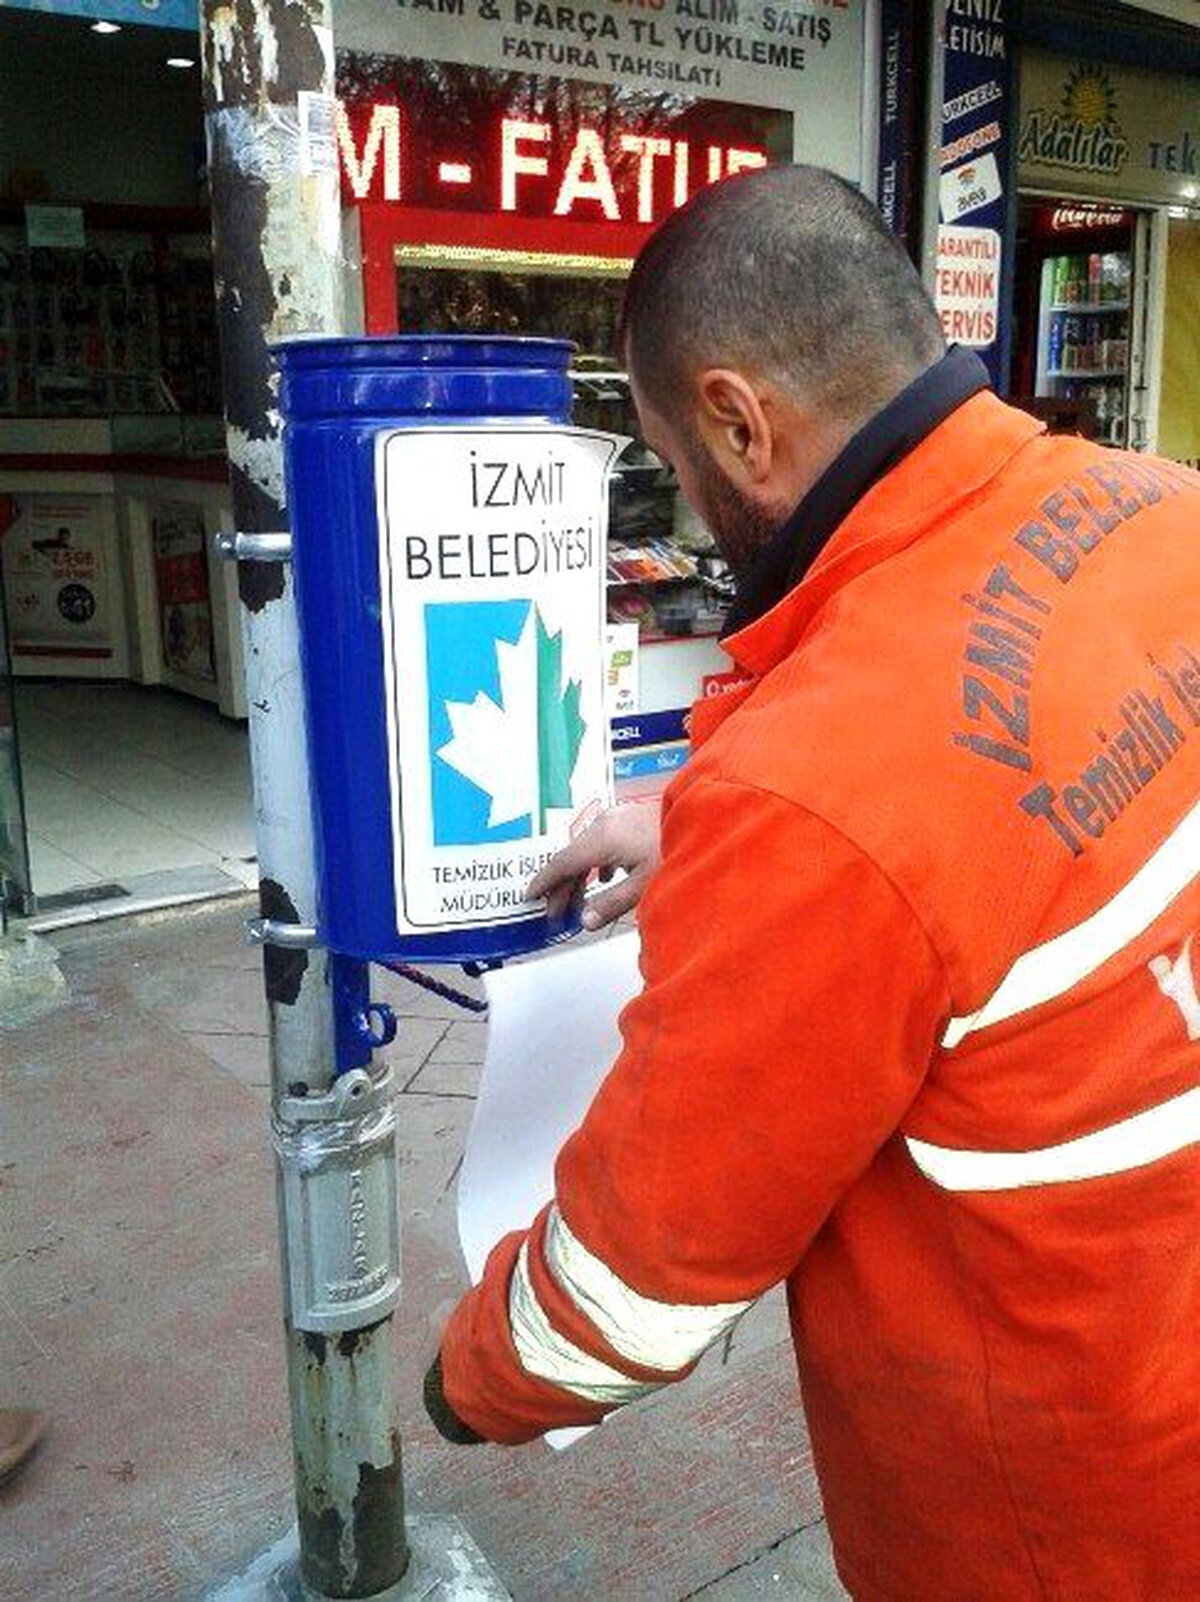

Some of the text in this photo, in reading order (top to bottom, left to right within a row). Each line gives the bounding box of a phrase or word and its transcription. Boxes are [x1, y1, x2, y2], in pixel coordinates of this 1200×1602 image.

[396, 0, 464, 16] AM
[478, 0, 501, 20] &
[514, 1, 619, 42] PARÇA
[629, 19, 664, 46] TL
[675, 26, 806, 70] YÜKLEME
[502, 36, 599, 69] FATURA
[762, 7, 832, 49] SATIŞ
[936, 266, 994, 299] EKNİK
[936, 304, 994, 339] ERVİS
[470, 450, 565, 508] İZMİT
[406, 517, 593, 580] BELEDİYESİ
[950, 560, 1052, 773] İZMİT
[1018, 688, 1186, 858] Temizlik
